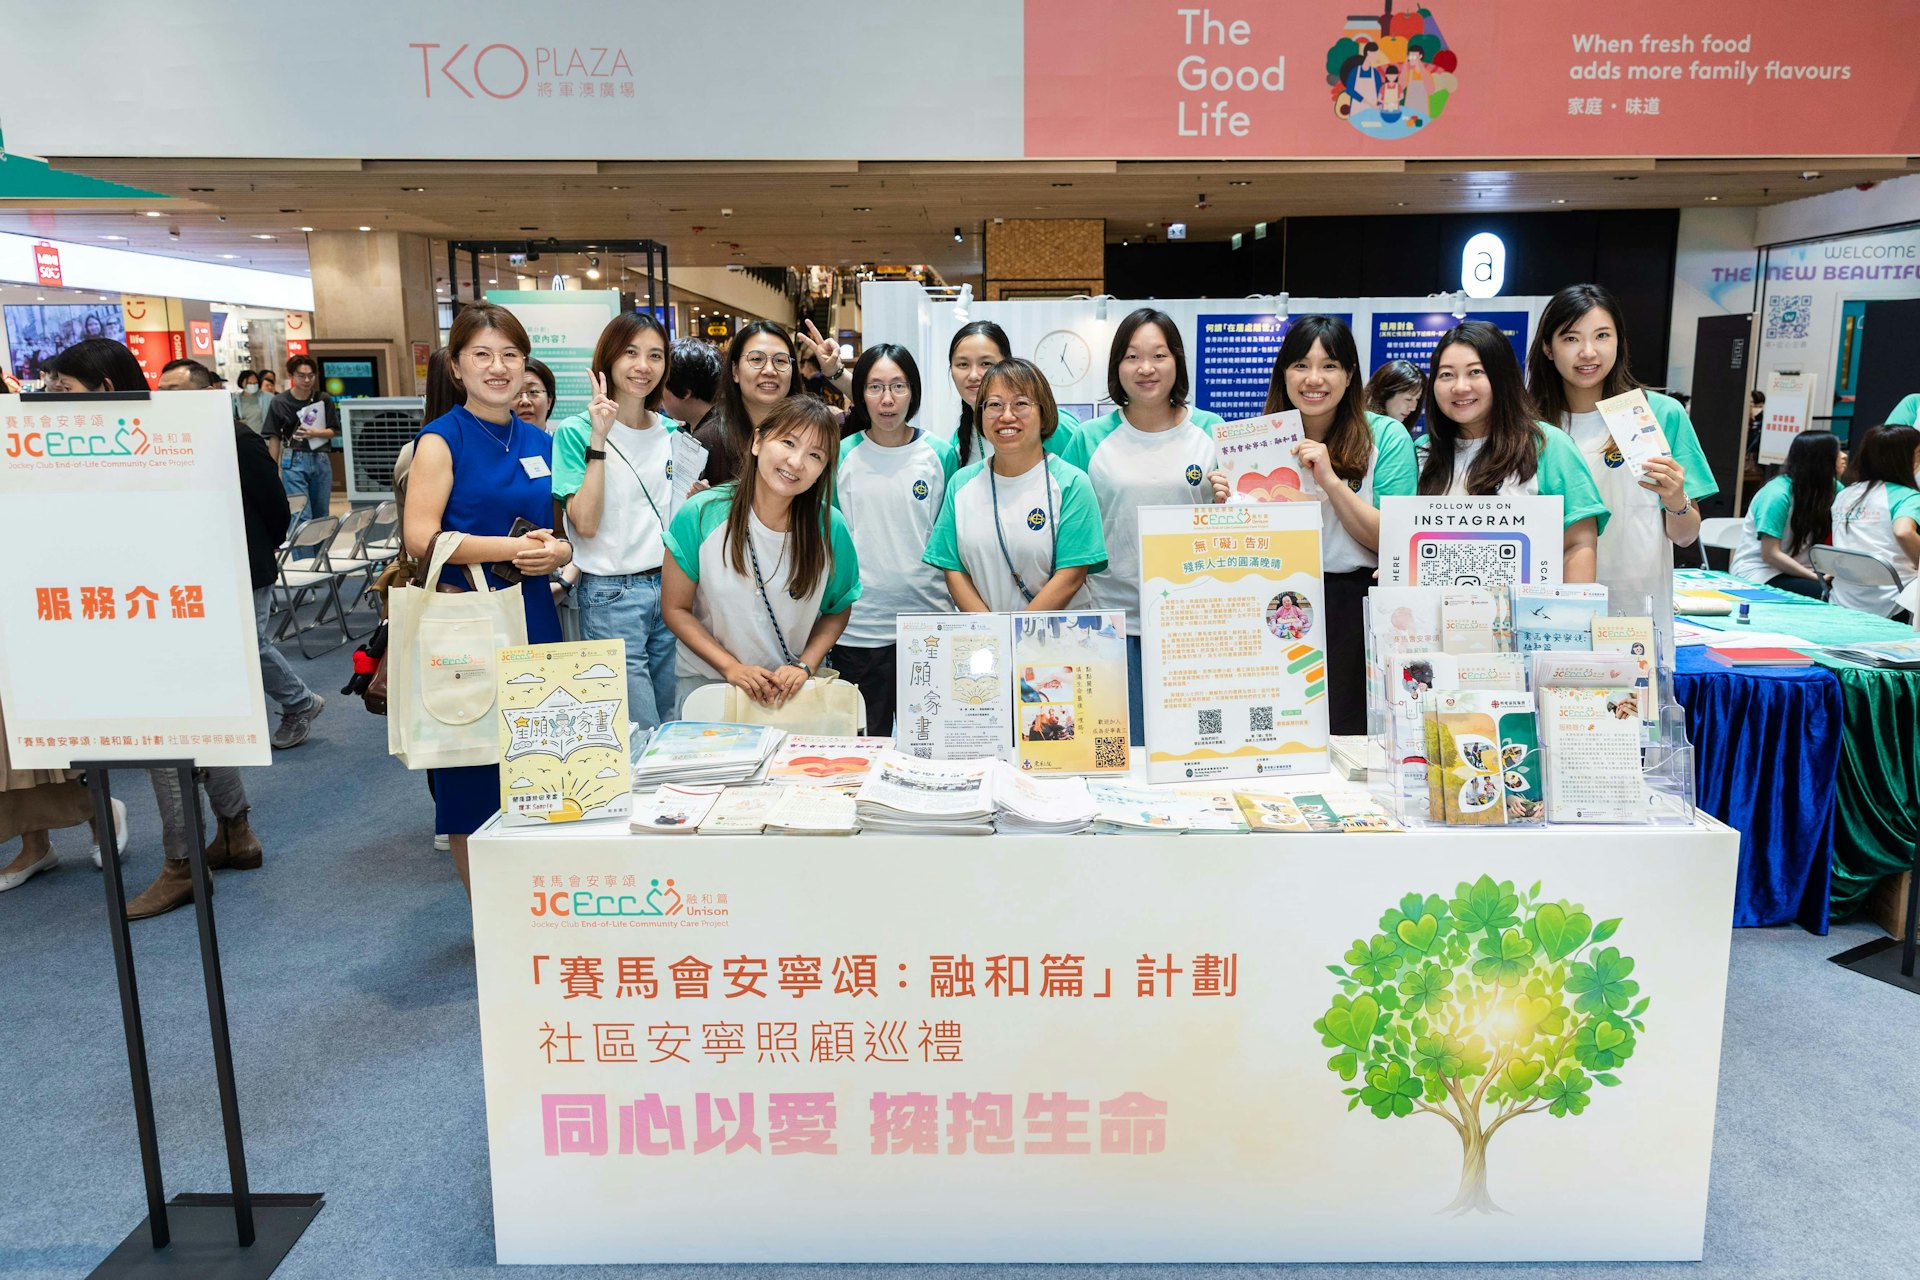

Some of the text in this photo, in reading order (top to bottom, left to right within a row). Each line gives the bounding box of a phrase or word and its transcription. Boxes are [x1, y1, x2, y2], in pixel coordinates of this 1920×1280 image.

[1177, 8, 1251, 46] The
[1572, 33, 1752, 53] When fresh food
[408, 43, 634, 100] TKO PLAZA
[1177, 55, 1286, 91] Good
[1569, 60, 1852, 85] adds more family flavours
[536, 81, 635, 99] 將軍澳廣場
[1177, 100, 1250, 137] Life
[1824, 244, 1917, 260] WELCOME
[1711, 266, 1752, 283] THE
[1767, 265, 1817, 281] NEW
[130, 335, 146, 345] life
[5, 415, 105, 429] 賽馬會安寧頌
[153, 446, 194, 456] Unison
[8, 462, 35, 470] Jockey
[36, 461, 54, 469] Club
[55, 461, 100, 469] End-of-Life
[100, 460, 147, 469] Community
[169, 459, 196, 467] Project
[1414, 515, 1526, 526] INSTAGRAM
[1392, 555, 1400, 582] HERE
[1540, 560, 1548, 583] SCA
[35, 584, 206, 621] 服務介紹
[531, 874, 637, 888] 賽馬會安寧頌
[686, 893, 729, 905] 融和篇
[686, 906, 729, 917] Unison
[531, 920, 729, 929] Jockey Club End-of-Life Community Care Project
[532, 952, 1239, 999] 「賽馬會安寧頌：融和篇」計劃
[538, 1019, 965, 1065] 社區安寧照顧巡禮
[541, 1090, 1169, 1157] 同心以愛 擁抱生命
